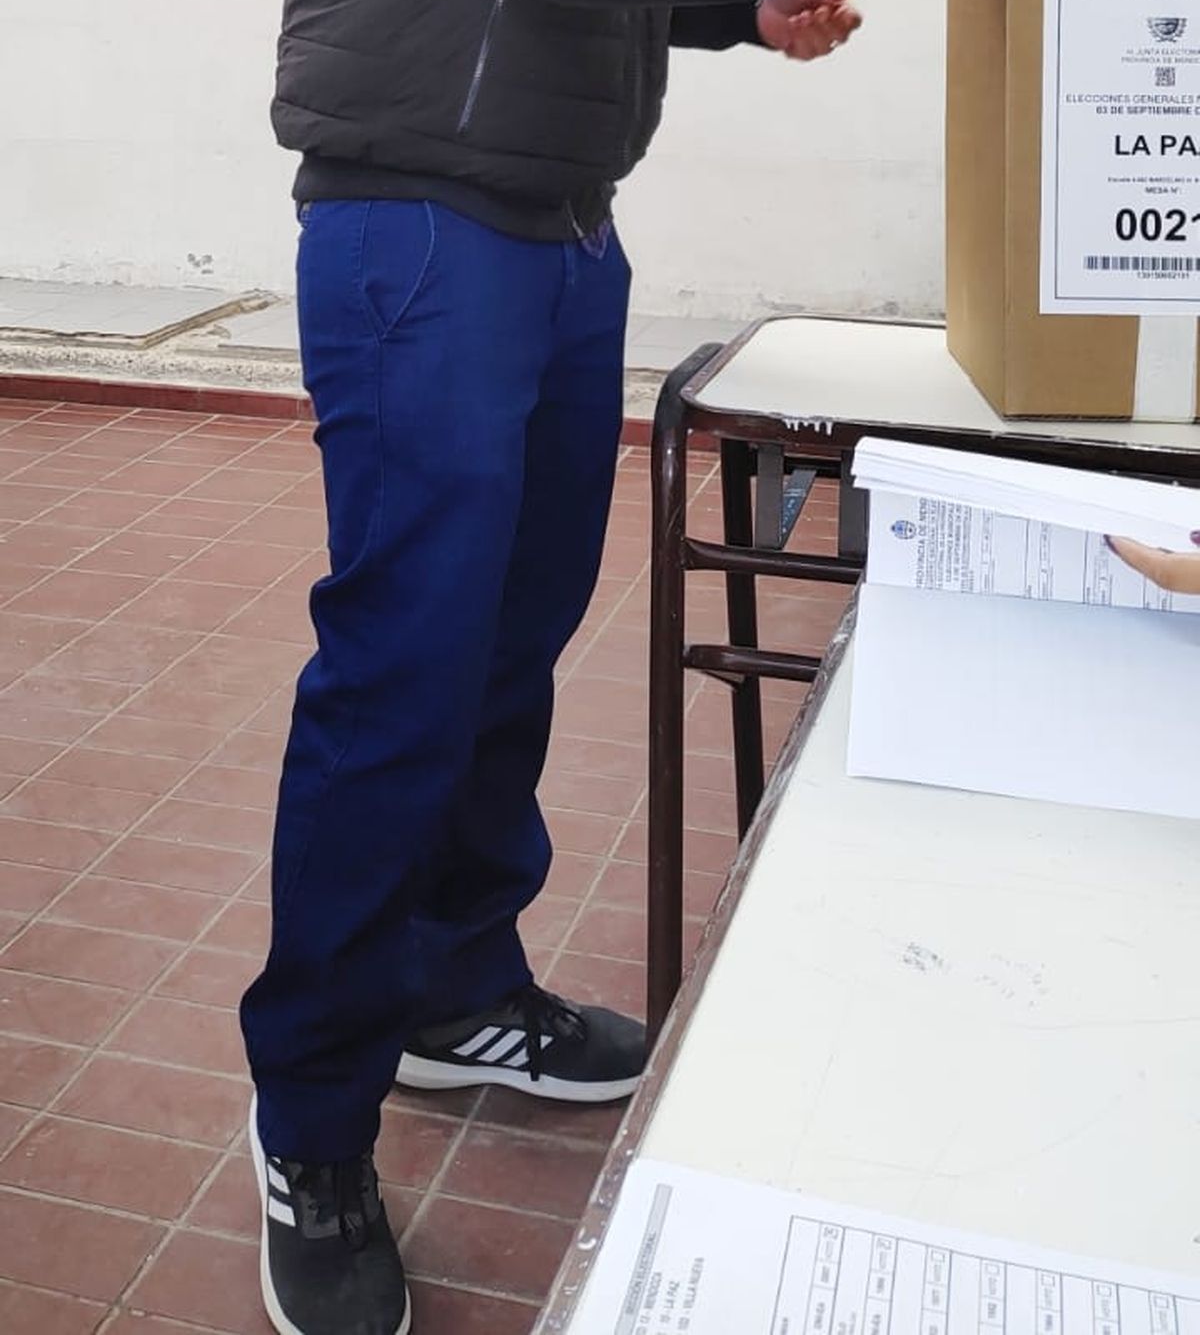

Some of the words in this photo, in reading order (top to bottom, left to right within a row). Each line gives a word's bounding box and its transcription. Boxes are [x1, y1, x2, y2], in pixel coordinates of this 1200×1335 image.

[1066, 94, 1130, 103] ELECCIONES
[1133, 94, 1194, 104] GENERALES
[1096, 106, 1108, 115] 03
[1110, 106, 1124, 115] DE
[1127, 106, 1192, 116] SEPTIEMBRE
[1115, 134, 1151, 156] LA
[1160, 134, 1200, 156] PA
[1145, 186, 1169, 195] MESA
[643, 1270, 663, 1310] MENDOZA
[667, 1280, 681, 1297] PAZ
